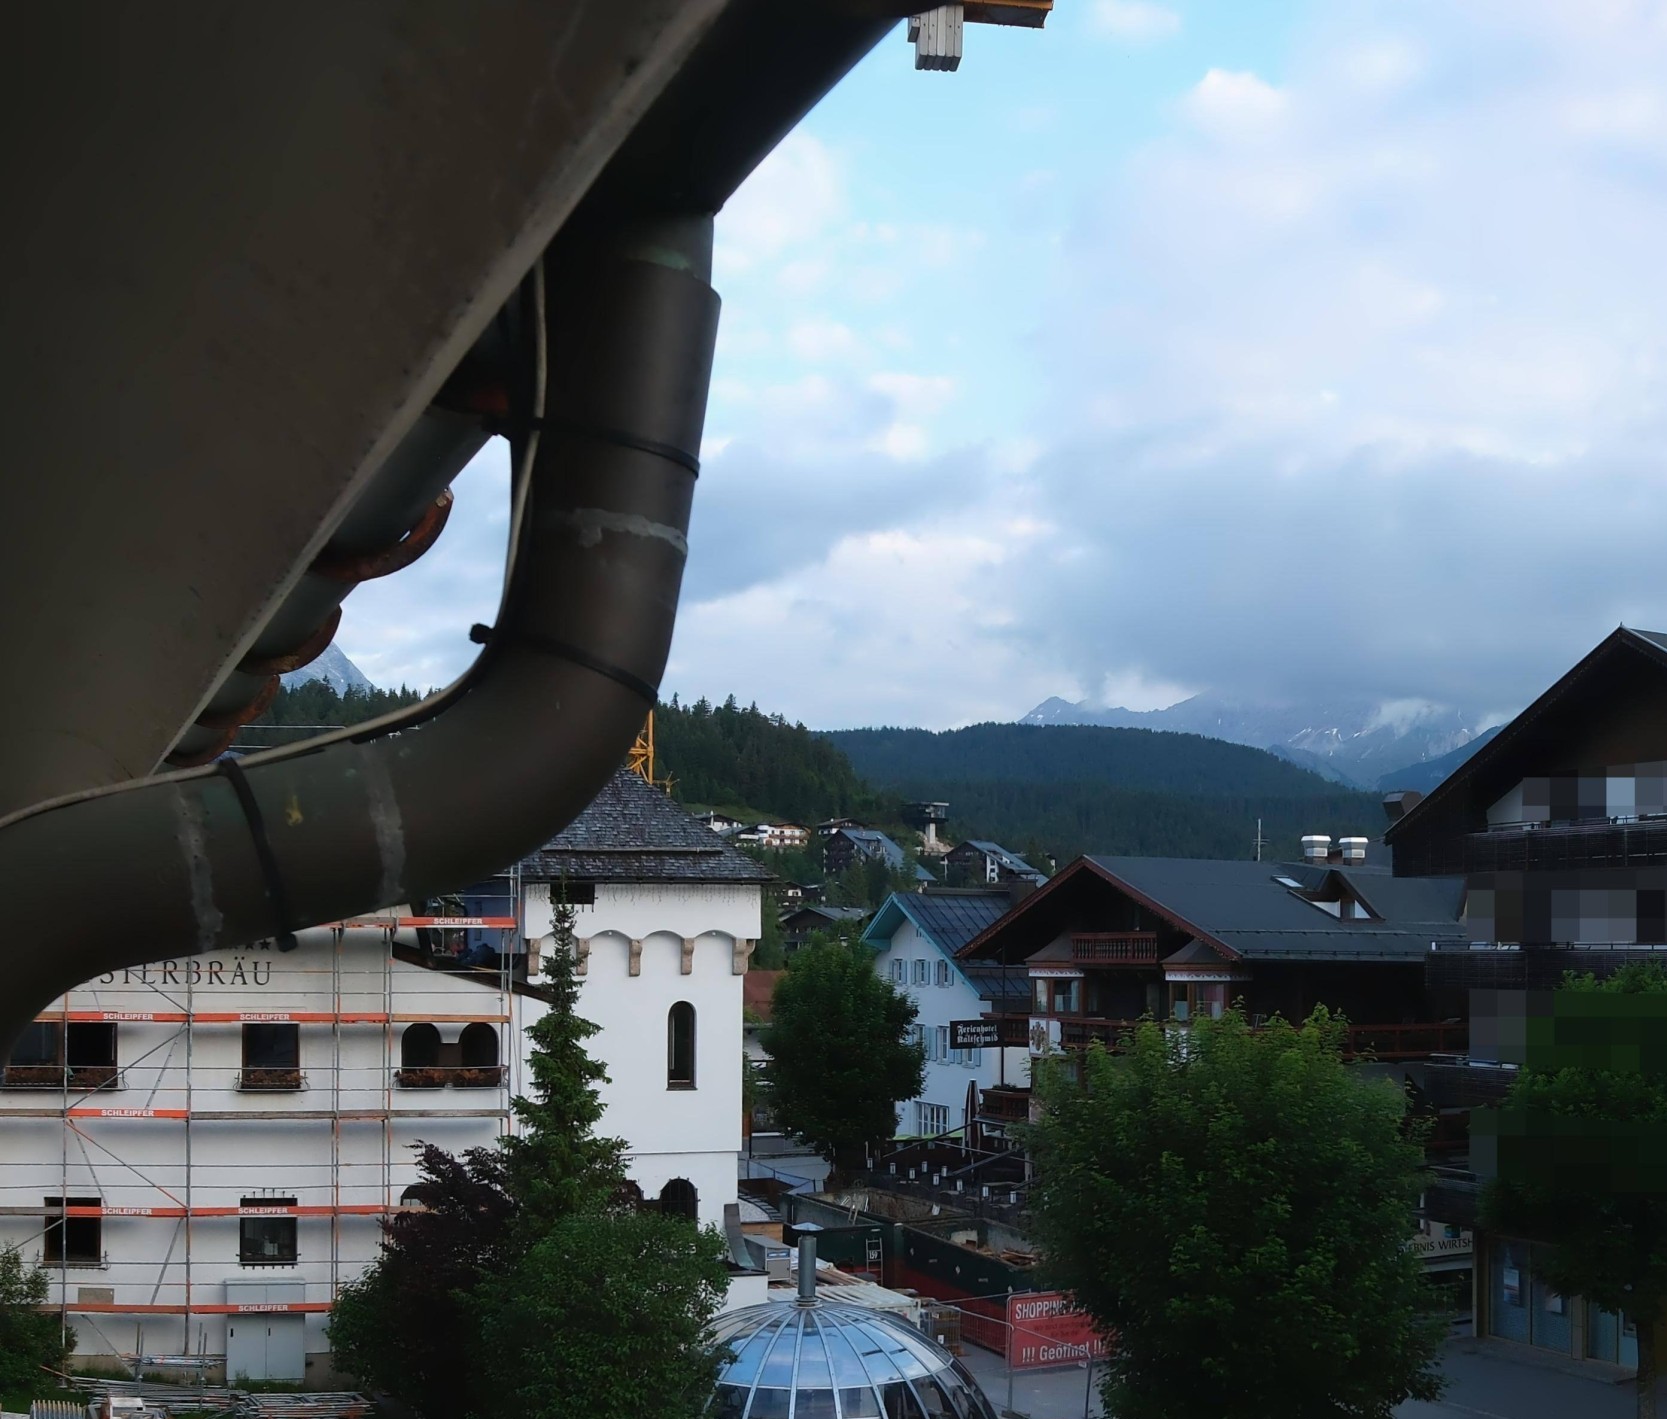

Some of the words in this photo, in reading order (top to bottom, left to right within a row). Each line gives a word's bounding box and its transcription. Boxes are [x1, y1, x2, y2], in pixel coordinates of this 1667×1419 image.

[101, 1109, 154, 1117] SCHLEIPFER
[238, 1304, 288, 1312] SCHLEIPFER
[1040, 1341, 1089, 1360] Geöffnet
